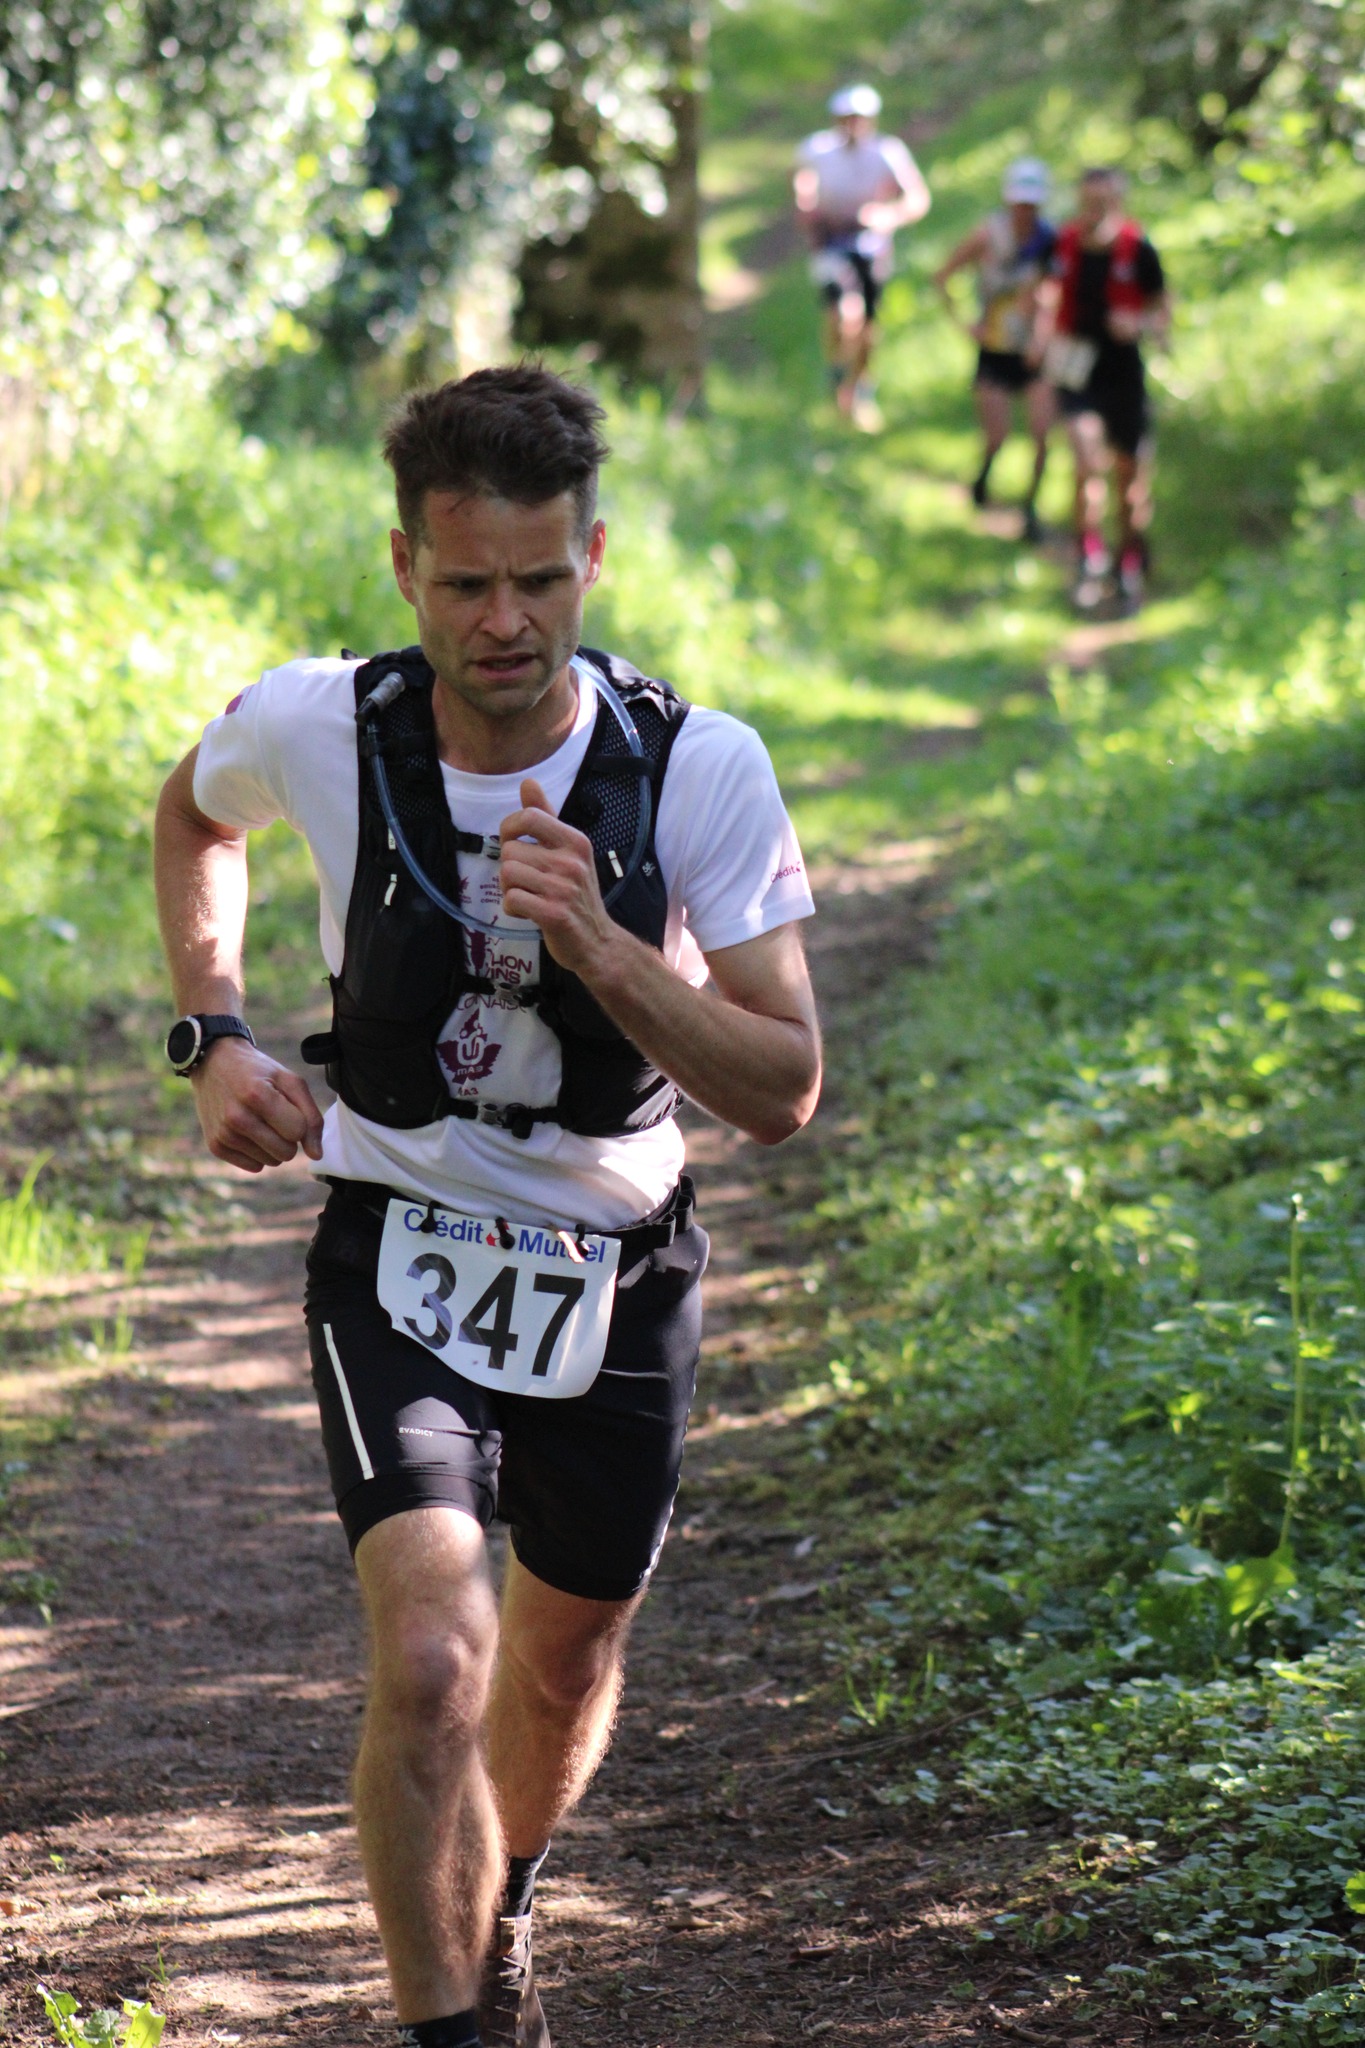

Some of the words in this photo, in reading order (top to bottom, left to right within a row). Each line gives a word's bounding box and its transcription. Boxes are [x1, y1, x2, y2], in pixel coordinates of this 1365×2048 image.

[403, 1208, 485, 1245] Cédit
[518, 1229, 606, 1264] Mutel
[402, 1252, 586, 1377] 347
[398, 1426, 434, 1438] EVADICT
